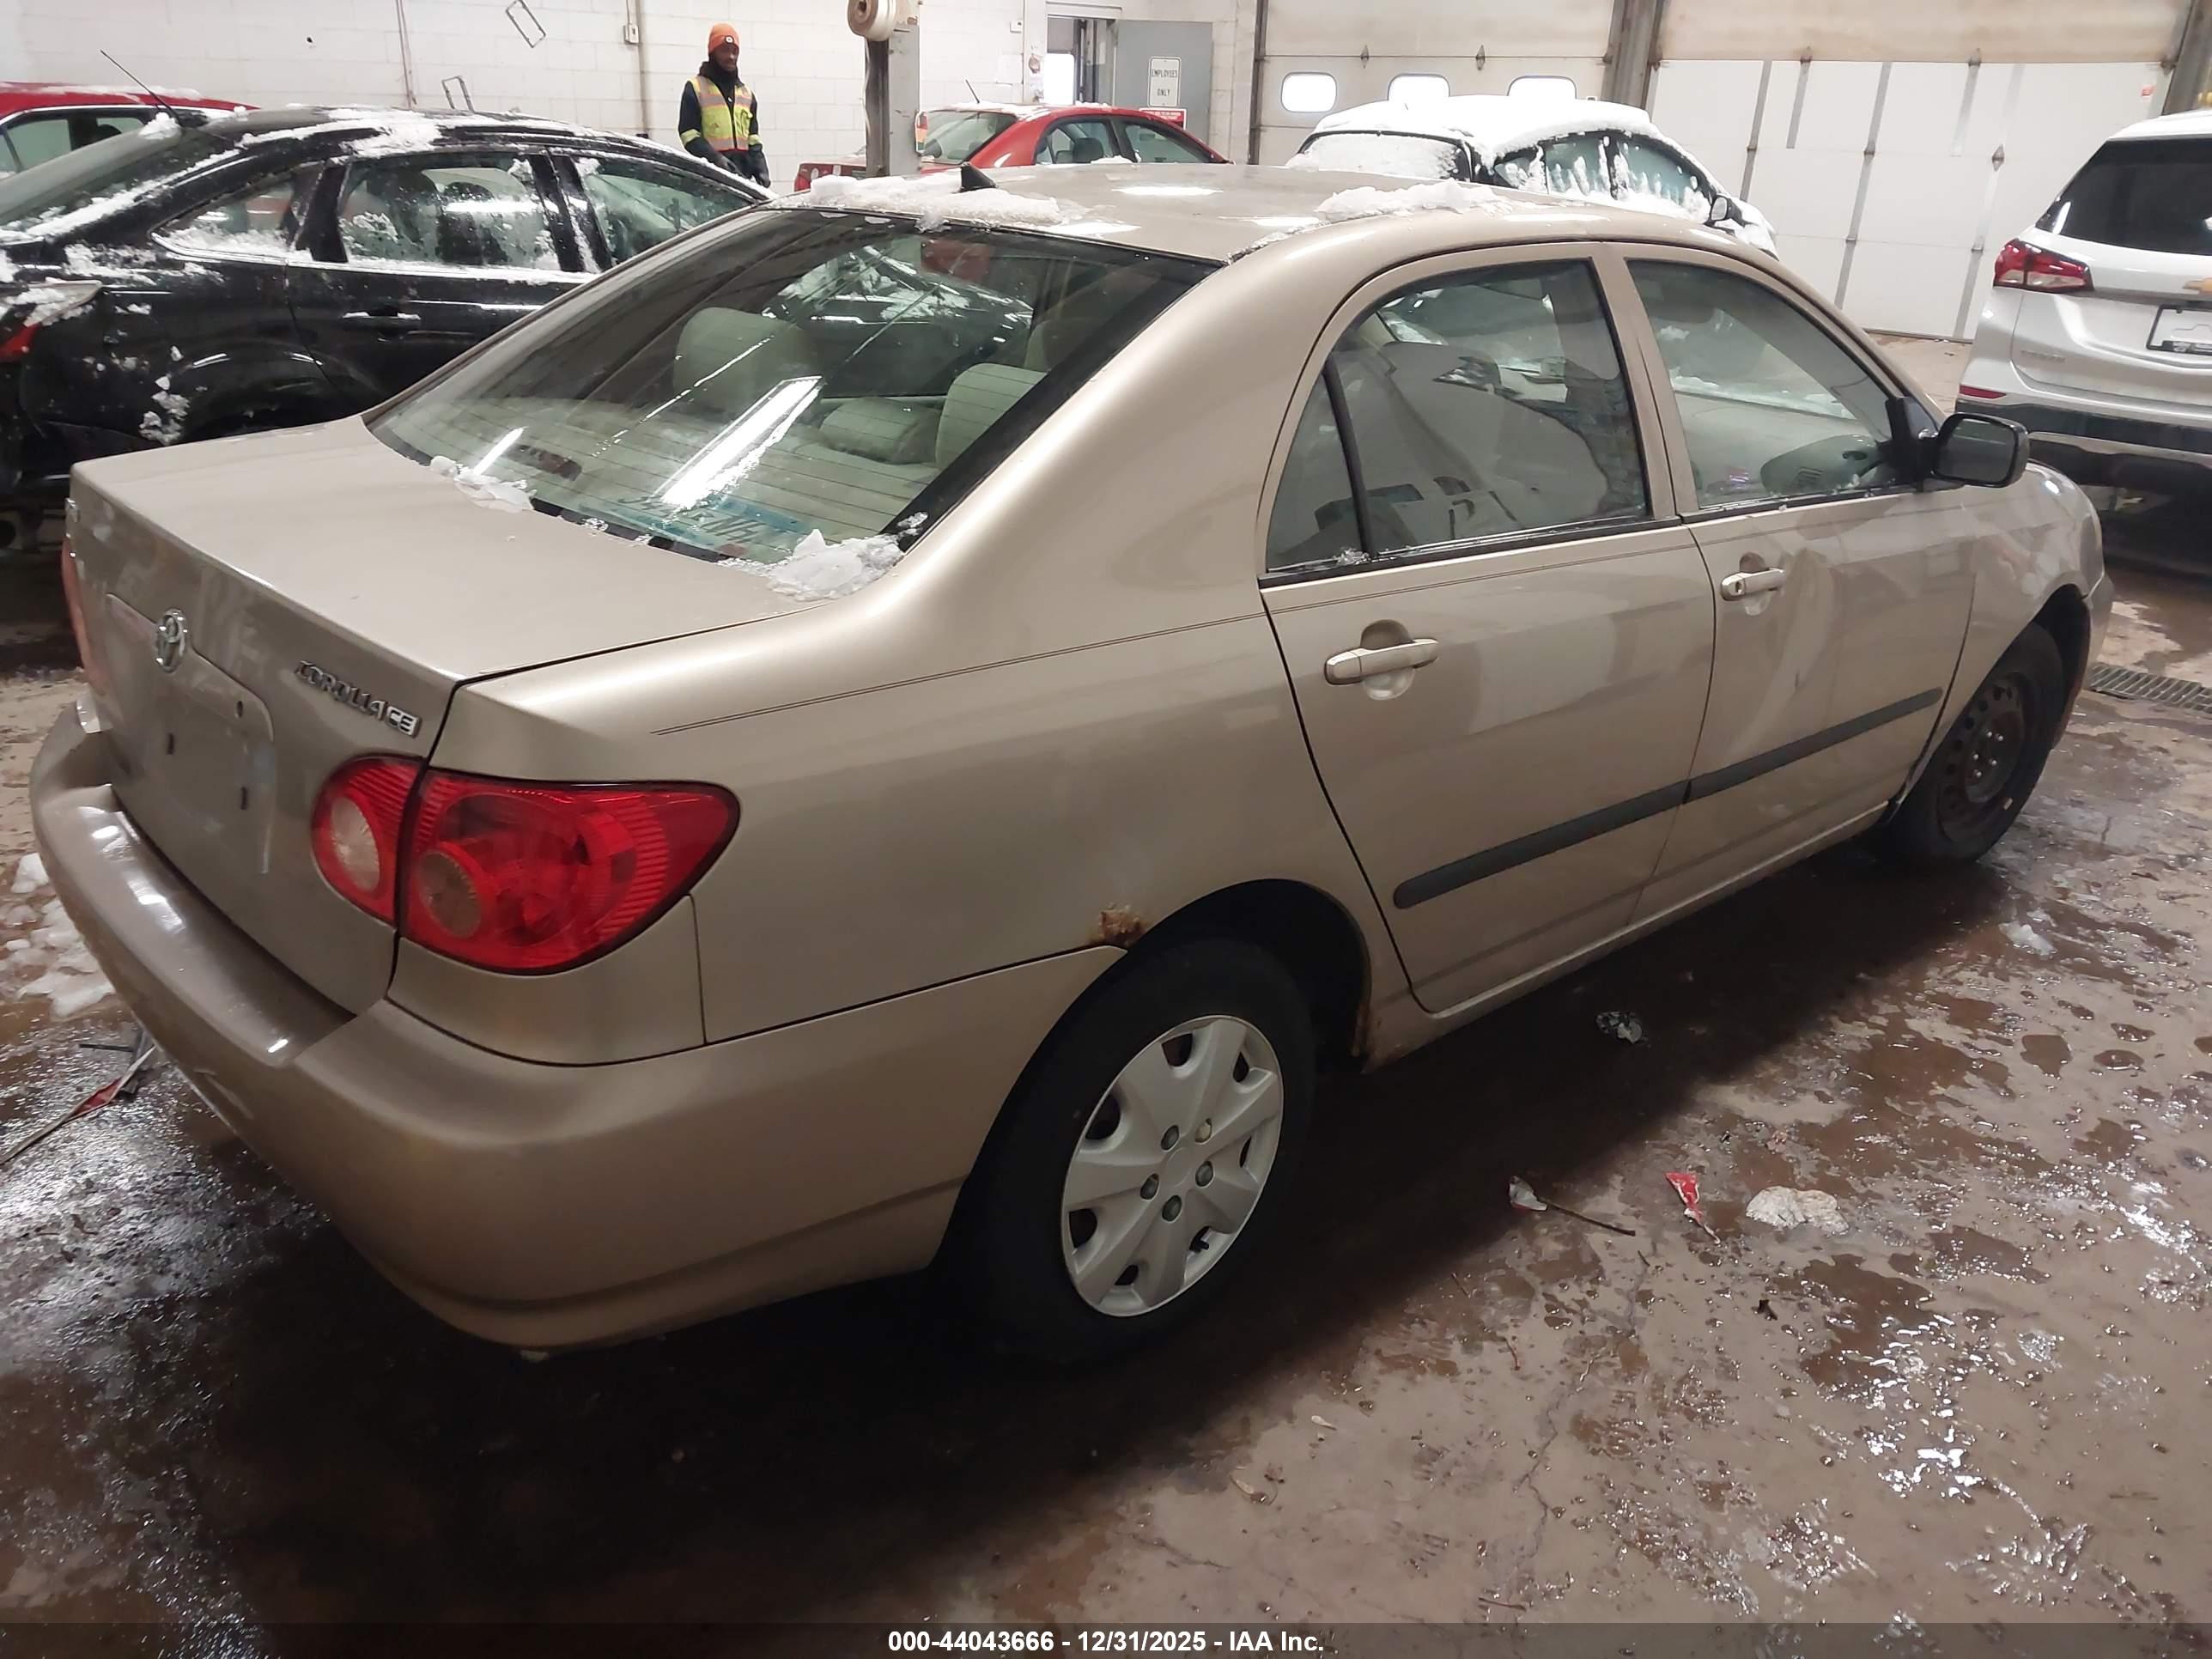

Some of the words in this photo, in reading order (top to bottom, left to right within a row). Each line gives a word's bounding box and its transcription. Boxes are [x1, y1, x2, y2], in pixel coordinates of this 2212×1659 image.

[1152, 69, 1177, 78] EMPLOYEES
[295, 659, 386, 720] COROLLA
[386, 706, 422, 738] CE
